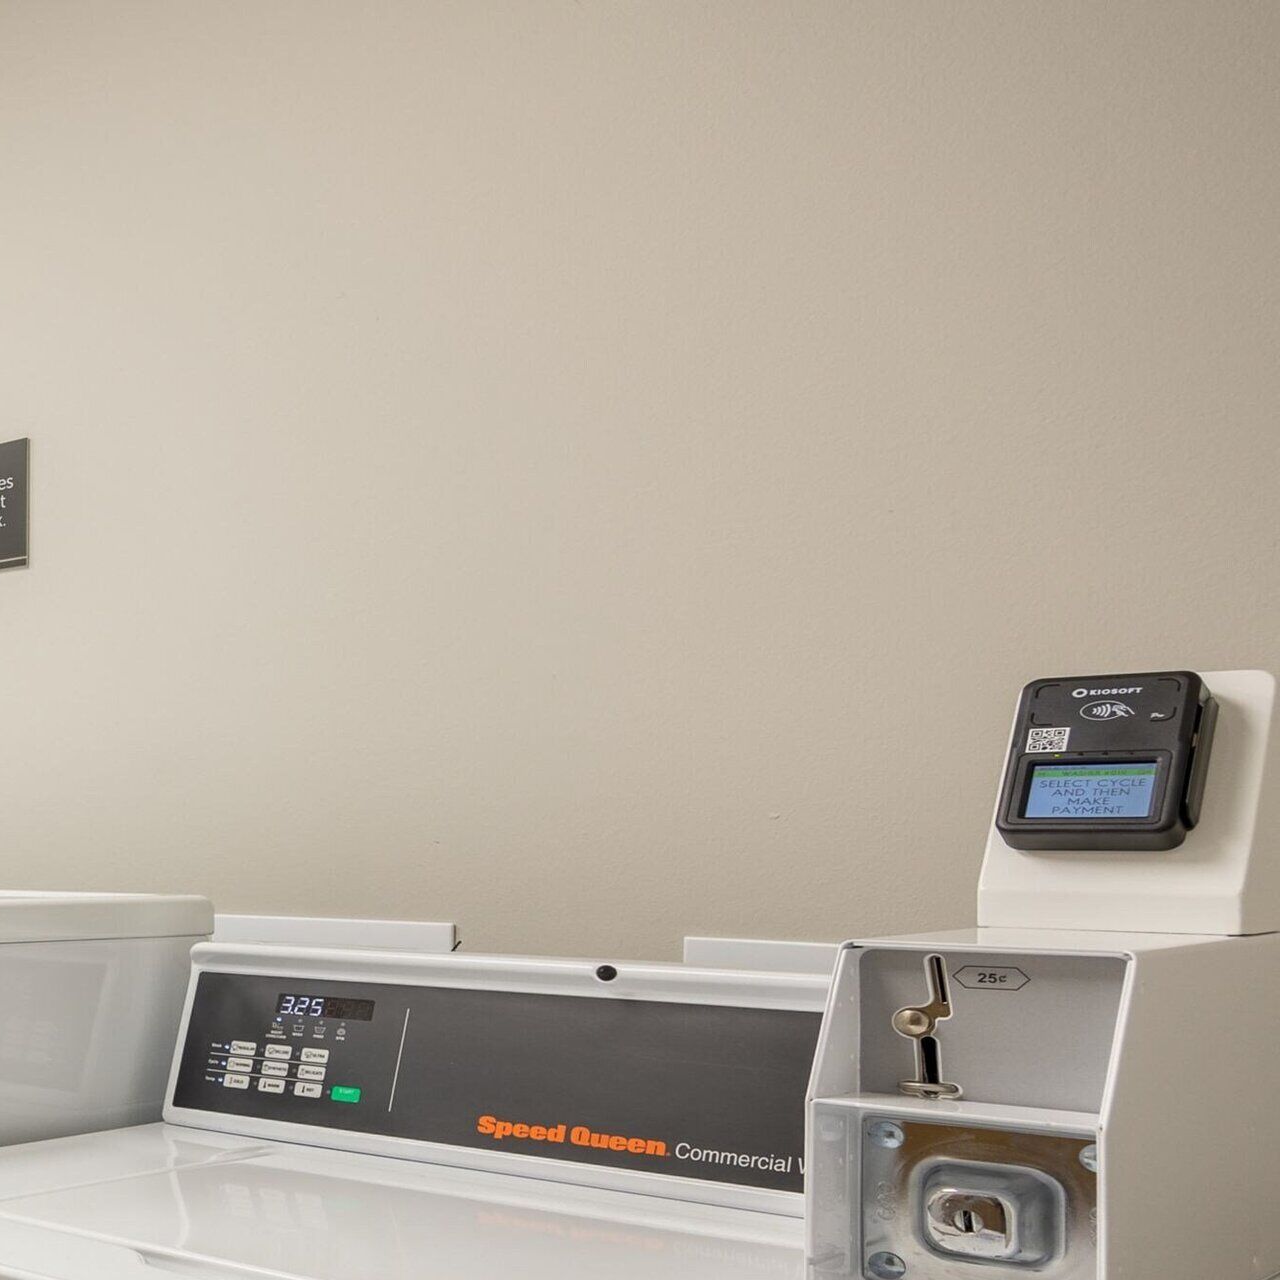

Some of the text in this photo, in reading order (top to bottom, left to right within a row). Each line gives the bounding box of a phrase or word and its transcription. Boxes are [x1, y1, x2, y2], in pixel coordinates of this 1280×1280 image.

[1089, 687, 1143, 696] KIOSOFT
[1040, 778, 1146, 788] SELECT CYCLE
[1051, 787, 1131, 797] AND THEN
[1067, 797, 1110, 806] MAKE
[1051, 806, 1124, 815] PAYMENT
[280, 996, 324, 1017] 3.25
[477, 1115, 567, 1144] Speed
[570, 1126, 667, 1157] Queen
[674, 1142, 792, 1173] Commercial
